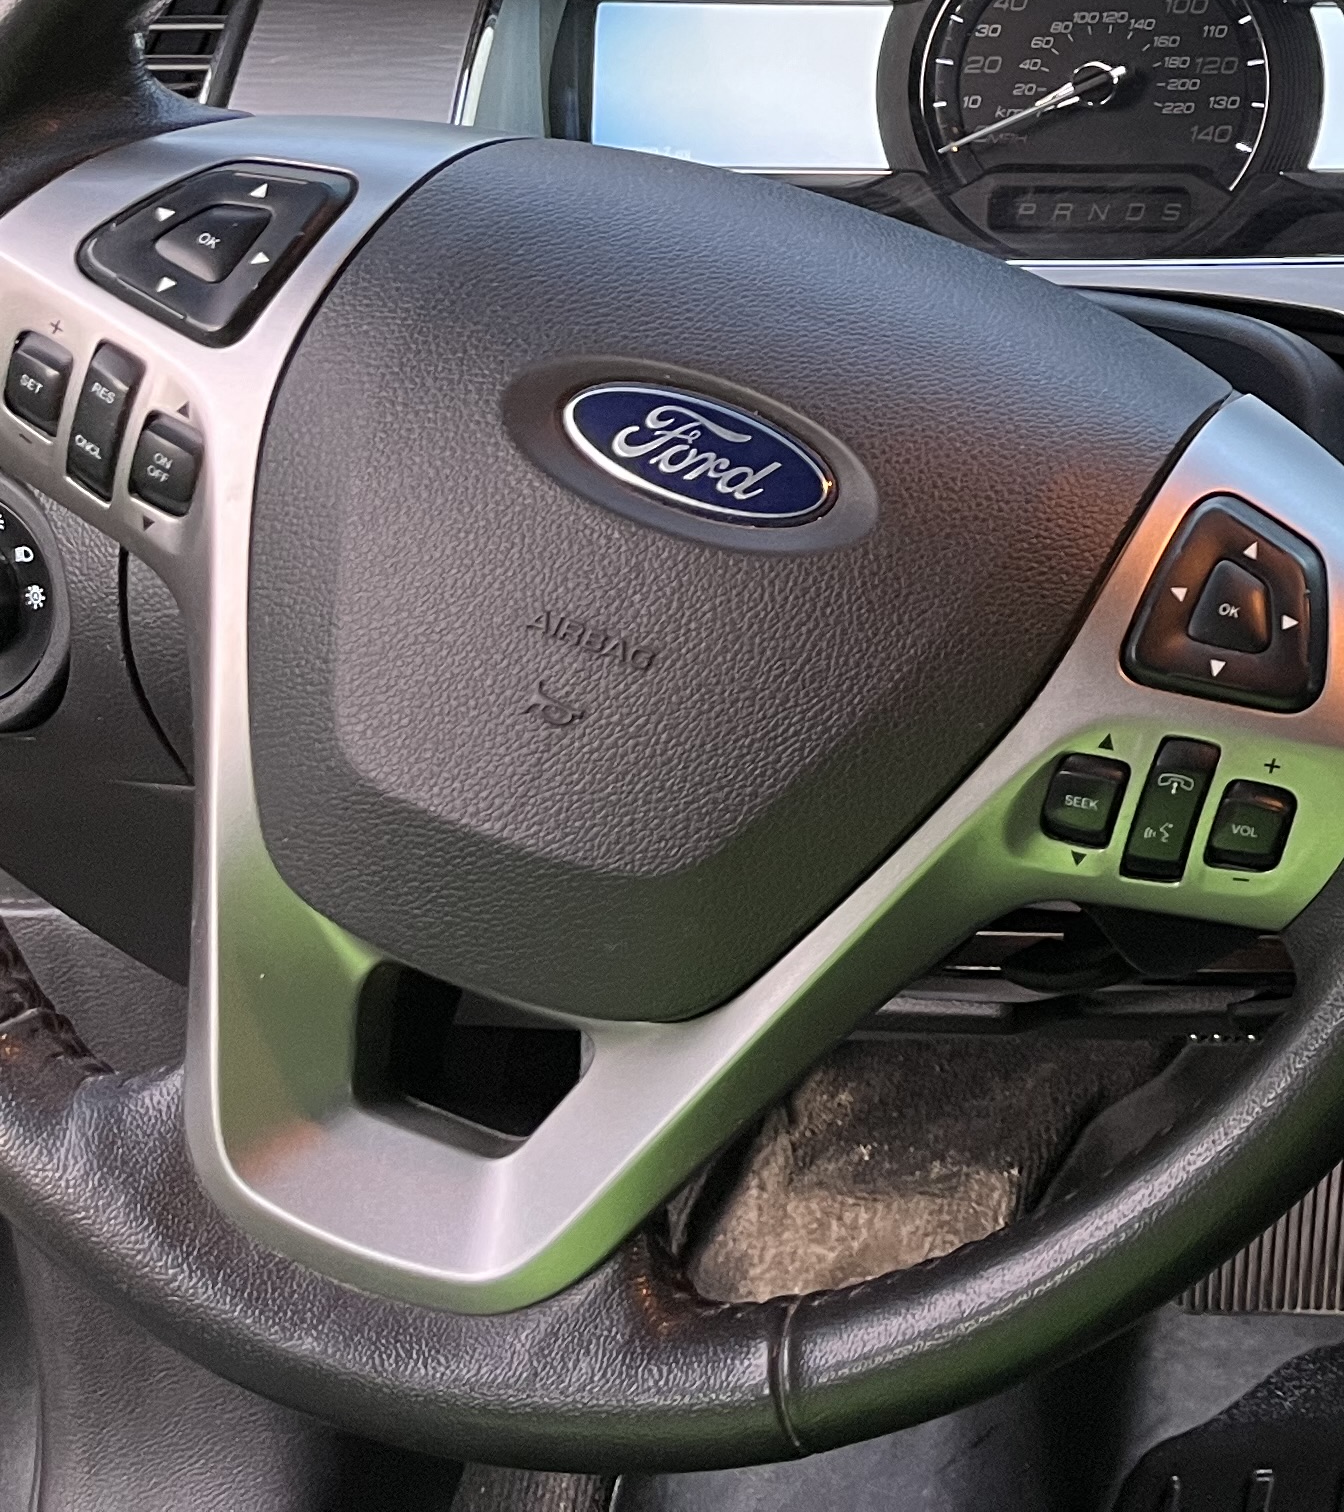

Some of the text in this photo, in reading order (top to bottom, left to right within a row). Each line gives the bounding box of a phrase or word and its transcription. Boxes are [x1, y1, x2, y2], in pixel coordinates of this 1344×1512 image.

[1073, 11, 1100, 24] 100
[1102, 11, 1129, 24] 120
[1129, 18, 1156, 31] 140
[974, 24, 1002, 37] 30
[1050, 21, 1073, 34] 80
[1202, 25, 1229, 38] 110
[1030, 36, 1054, 49] 60
[1153, 35, 1181, 48] 160
[964, 56, 1002, 74] 20
[1019, 58, 1042, 71] 40
[1163, 56, 1191, 69] 180
[1195, 57, 1239, 75] 120
[1012, 83, 1037, 96] 20
[1167, 78, 1200, 91] 200
[962, 95, 982, 109] 10
[1161, 102, 1195, 114] 220
[1209, 95, 1241, 109] 130
[1190, 125, 1233, 143] 140
[1016, 203, 1183, 220] P R N D S
[198, 231, 221, 251] OK
[19, 373, 43, 395] SET
[91, 381, 116, 405] RES
[611, 405, 782, 500] Ford
[153, 452, 173, 470] ON
[146, 464, 170, 483] OFF
[1218, 602, 1240, 619] OK
[1064, 793, 1099, 811] SEEK
[1231, 823, 1258, 839] VOL
